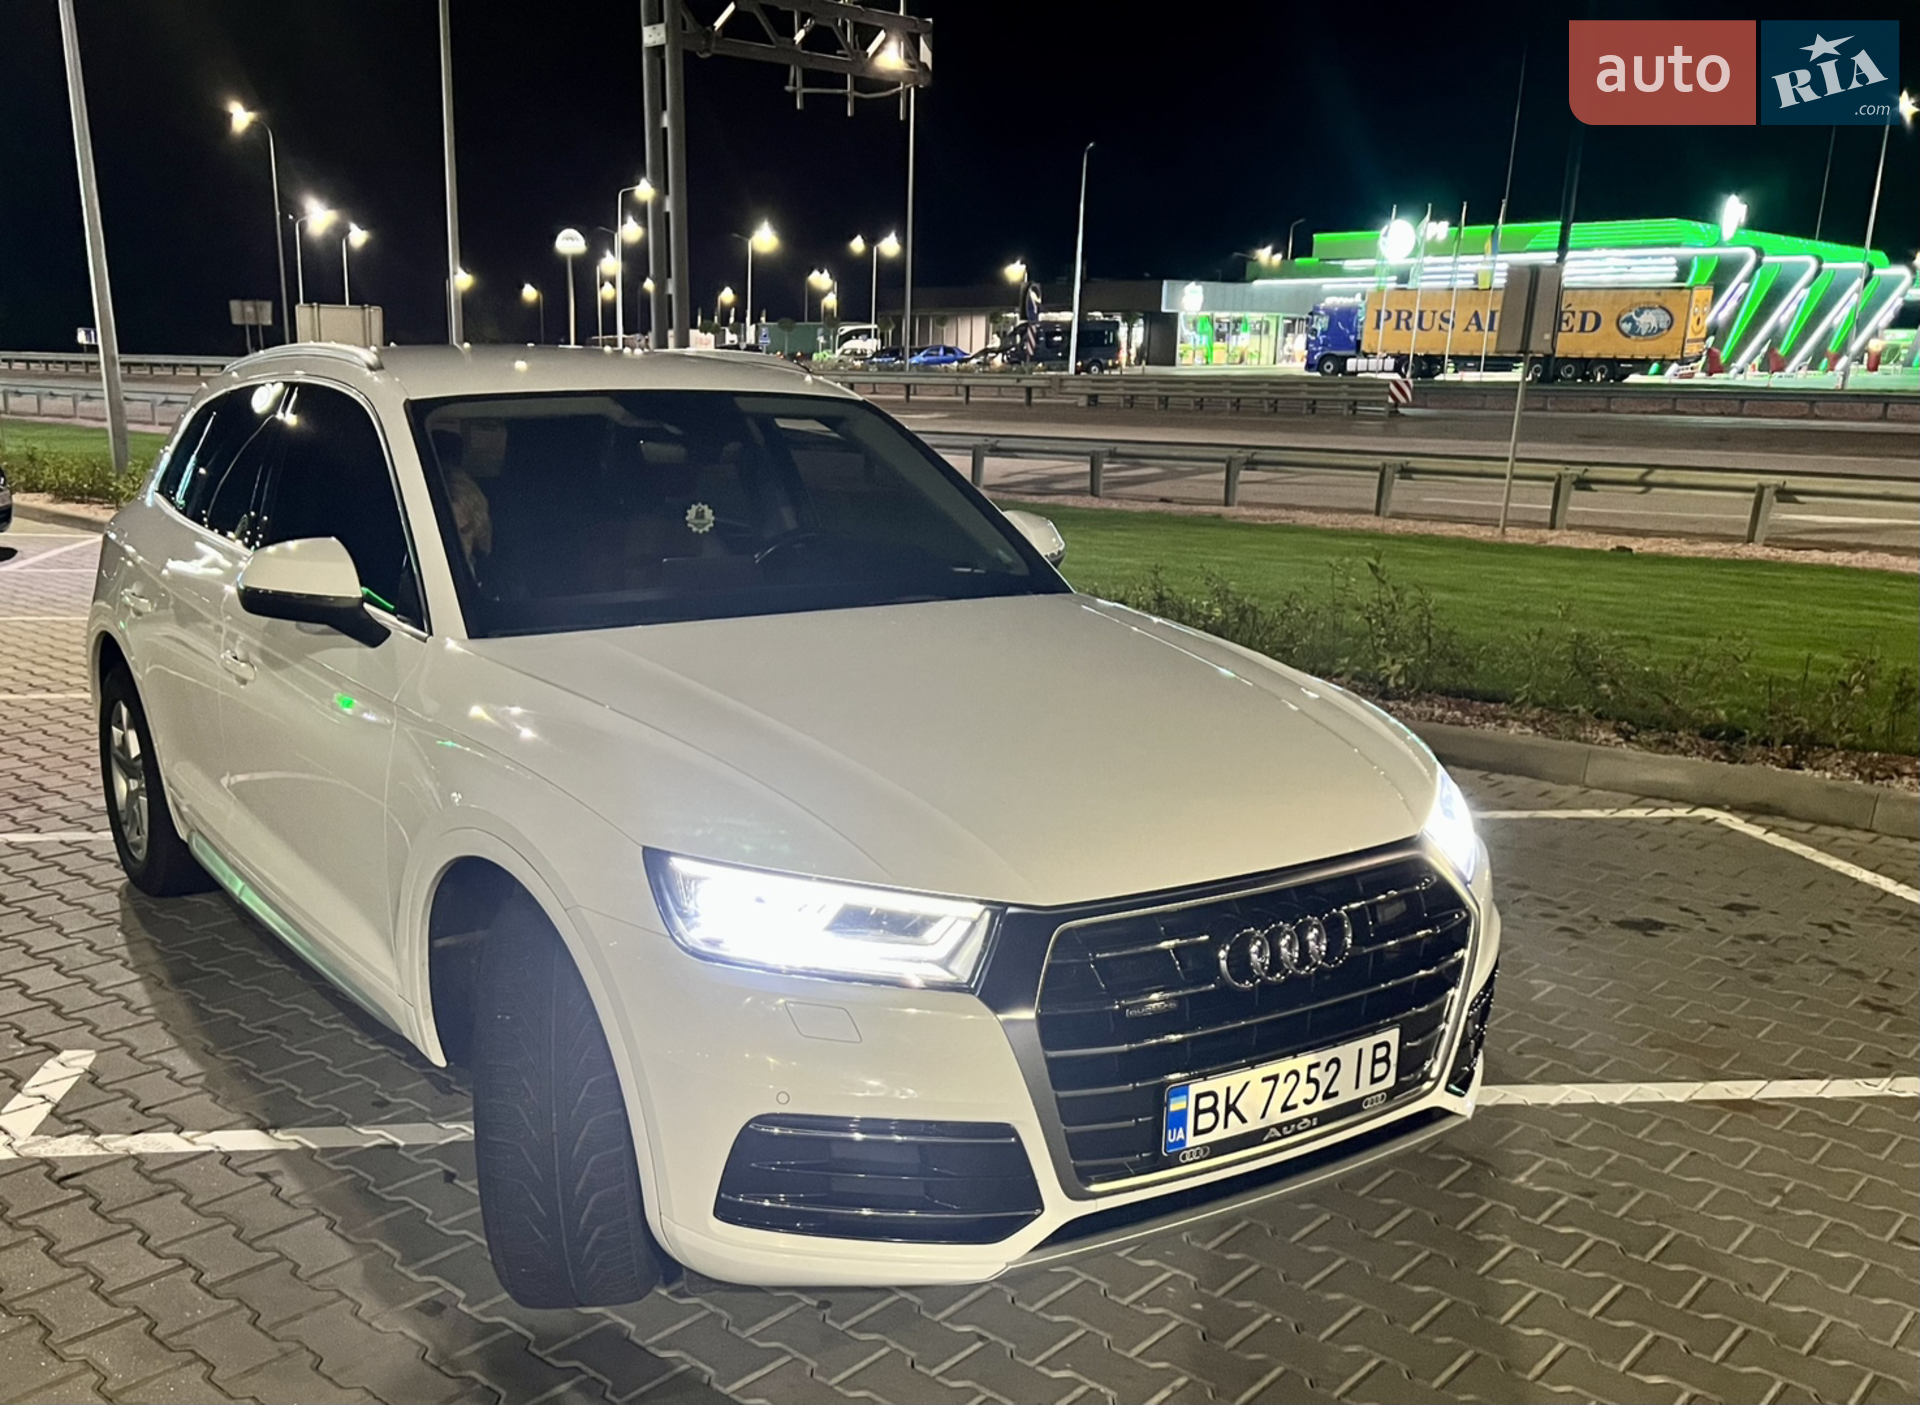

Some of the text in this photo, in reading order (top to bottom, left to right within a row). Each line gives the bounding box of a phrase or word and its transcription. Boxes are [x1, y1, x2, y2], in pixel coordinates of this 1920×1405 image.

[1372, 308, 1456, 332] PRUS
[1193, 1040, 1392, 1138] BK 7252 IB
[1168, 1127, 1185, 1143] UA
[1263, 1117, 1318, 1141] Audi
